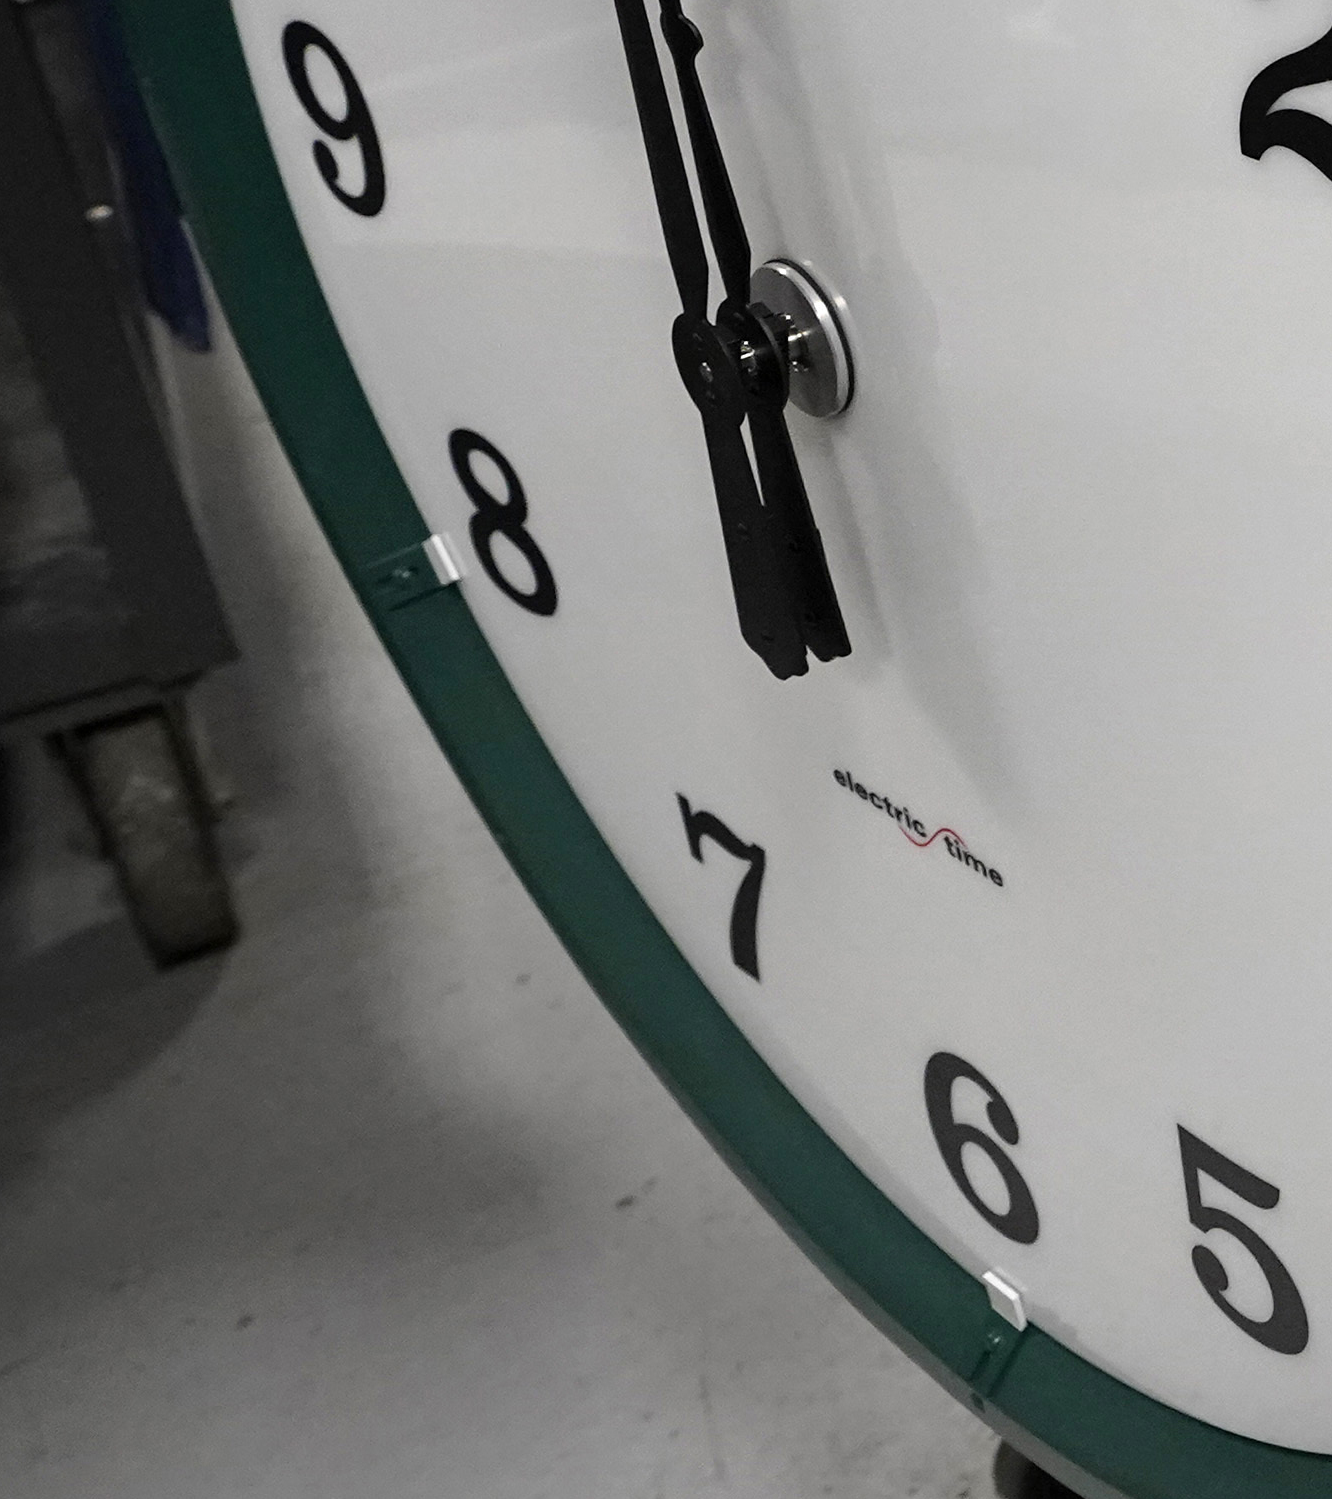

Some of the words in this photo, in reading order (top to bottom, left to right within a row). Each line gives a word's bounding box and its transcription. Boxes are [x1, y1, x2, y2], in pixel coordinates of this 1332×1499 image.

[282, 20, 386, 217] 9
[448, 428, 558, 617] 8
[677, 793, 766, 982] 7
[833, 769, 927, 838] electric
[943, 835, 1003, 887] time
[924, 1052, 1039, 1244] 6
[1177, 1124, 1309, 1355] 5
